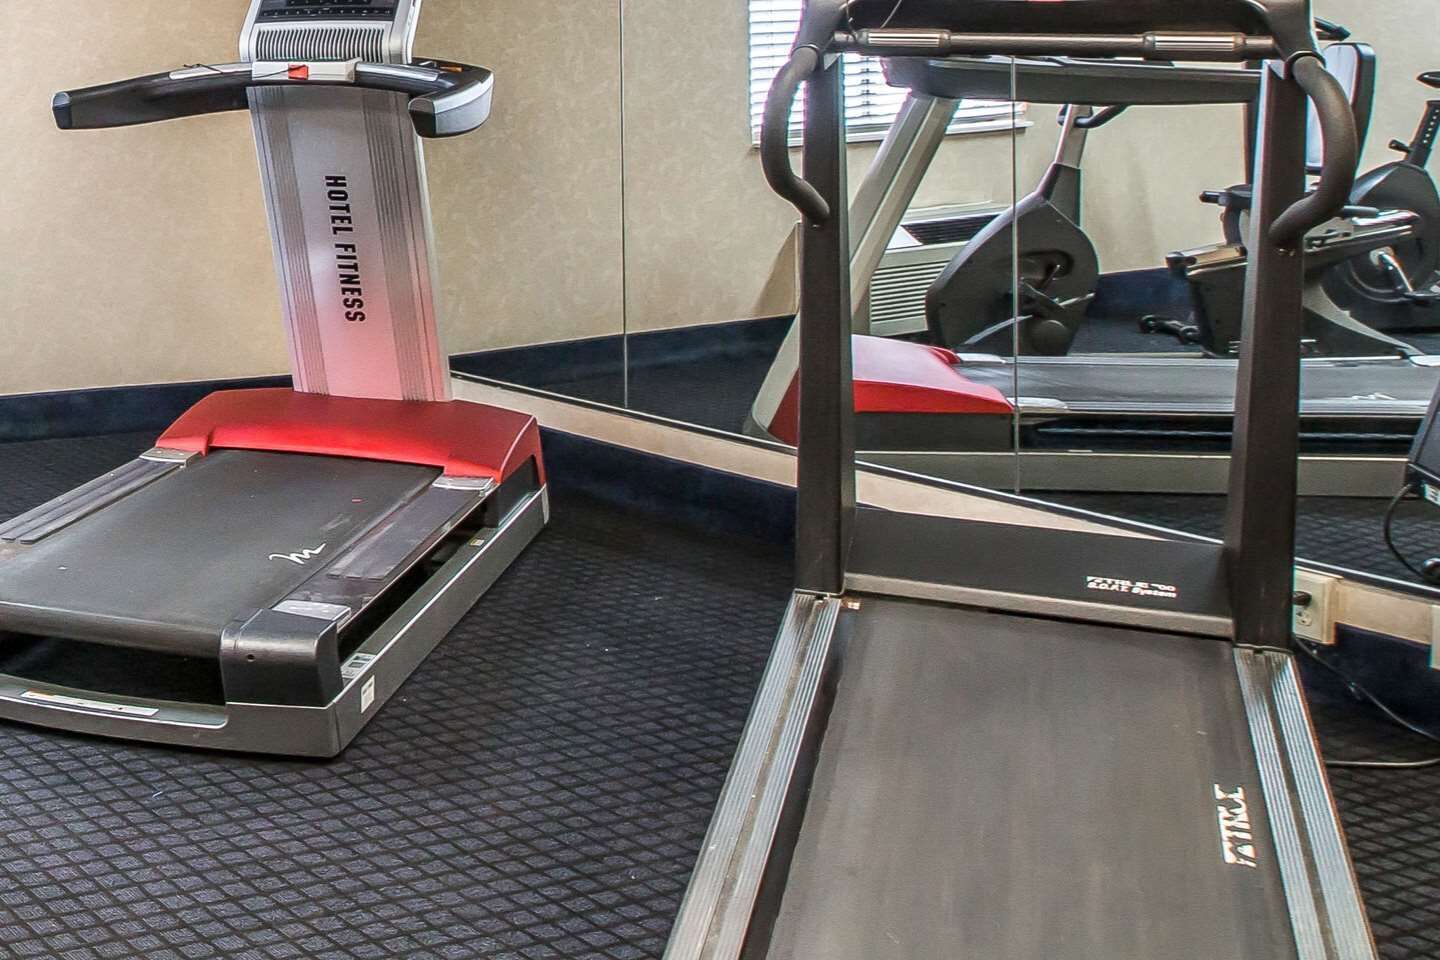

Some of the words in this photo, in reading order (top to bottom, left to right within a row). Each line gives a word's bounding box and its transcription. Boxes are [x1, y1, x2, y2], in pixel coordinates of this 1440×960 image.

[324, 175, 354, 235] HOTEL
[334, 243, 366, 322] FITNESS
[1213, 783, 1252, 842] TRUE
